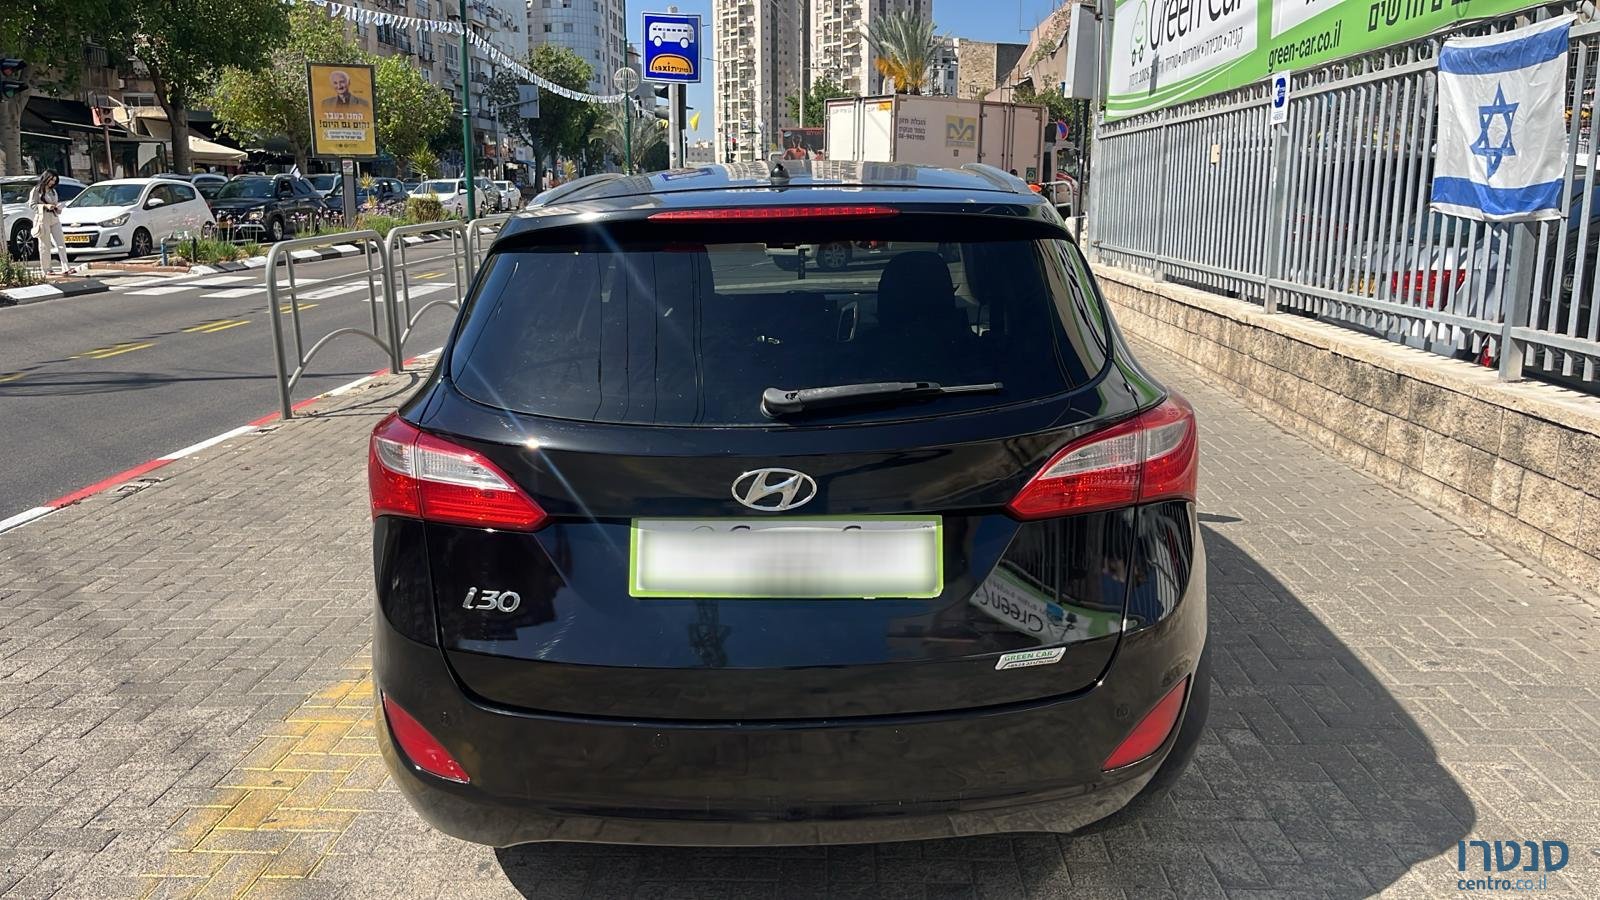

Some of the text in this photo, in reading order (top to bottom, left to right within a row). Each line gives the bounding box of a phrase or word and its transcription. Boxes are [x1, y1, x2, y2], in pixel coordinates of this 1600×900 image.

[1205, 34, 1222, 56] מכירה
[1227, 26, 1243, 50] קניה
[1268, 20, 1342, 73] green-car.co.il
[655, 62, 670, 71] taxi
[319, 119, 339, 129] היום!
[462, 586, 521, 613] i30
